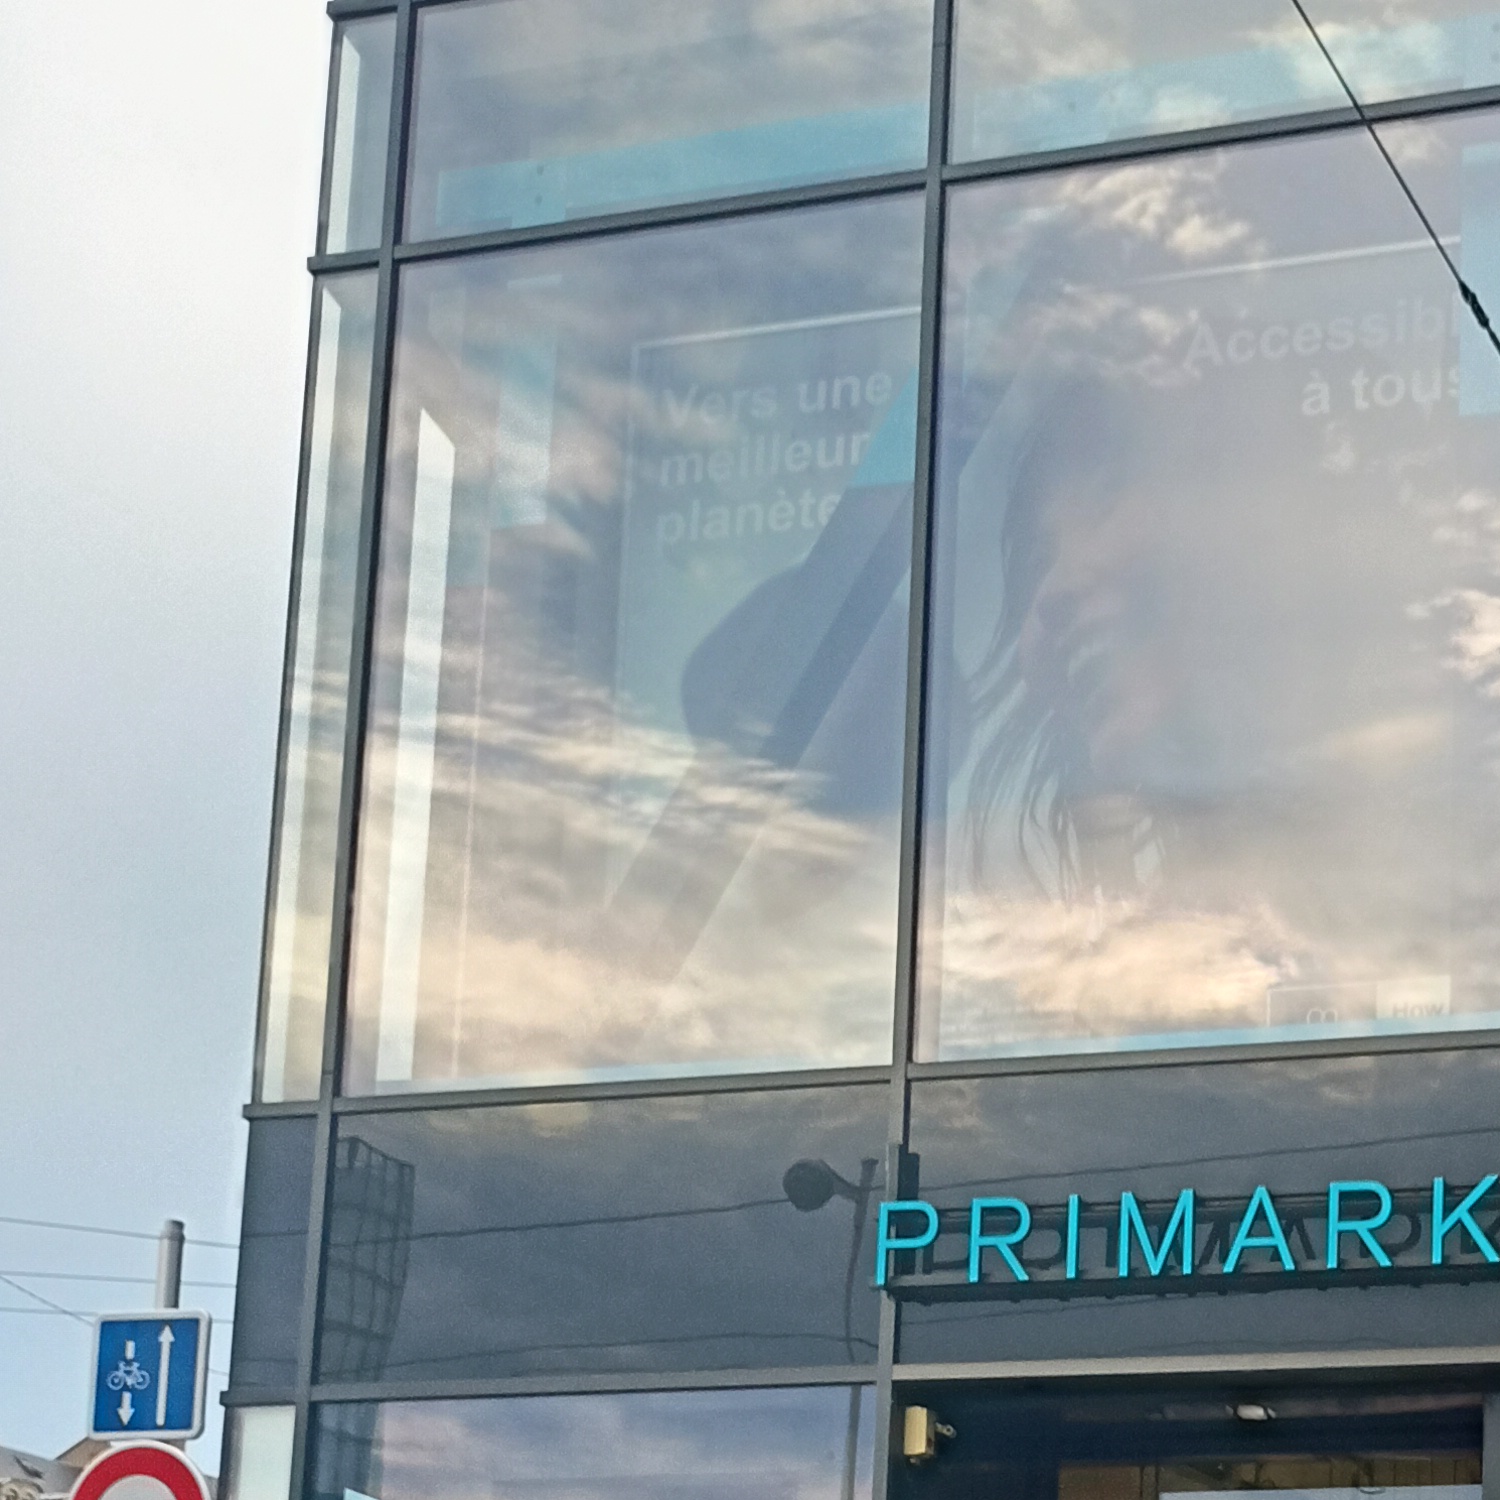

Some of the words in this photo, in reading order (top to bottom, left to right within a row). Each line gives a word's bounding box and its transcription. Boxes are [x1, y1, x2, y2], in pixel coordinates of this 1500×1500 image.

[662, 383, 778, 427] Vers
[797, 370, 893, 413] une
[1302, 368, 1331, 416] à
[876, 1173, 1500, 1287] PRIMARK
